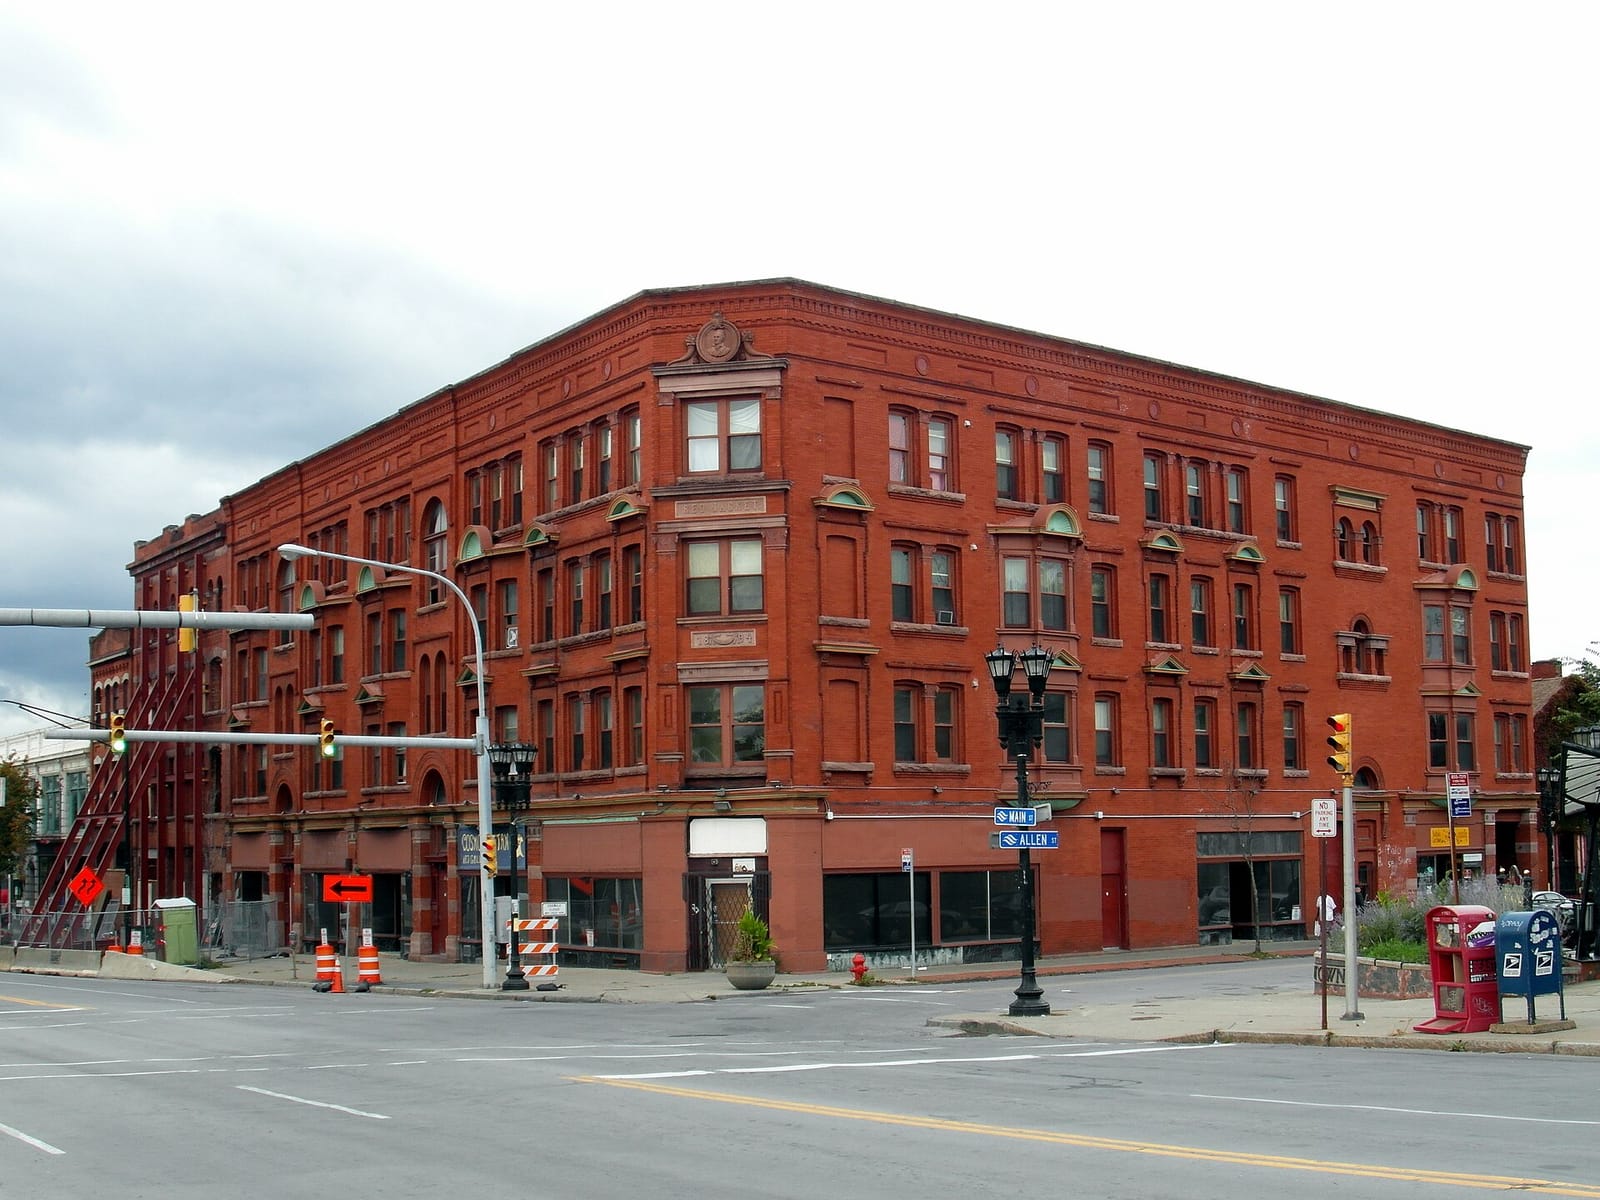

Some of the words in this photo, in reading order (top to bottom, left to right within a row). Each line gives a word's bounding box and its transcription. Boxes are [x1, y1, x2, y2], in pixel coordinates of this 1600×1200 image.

[1319, 802, 1329, 810] NO
[1009, 811, 1026, 822] MAIN
[1020, 834, 1047, 845] ALLEN
